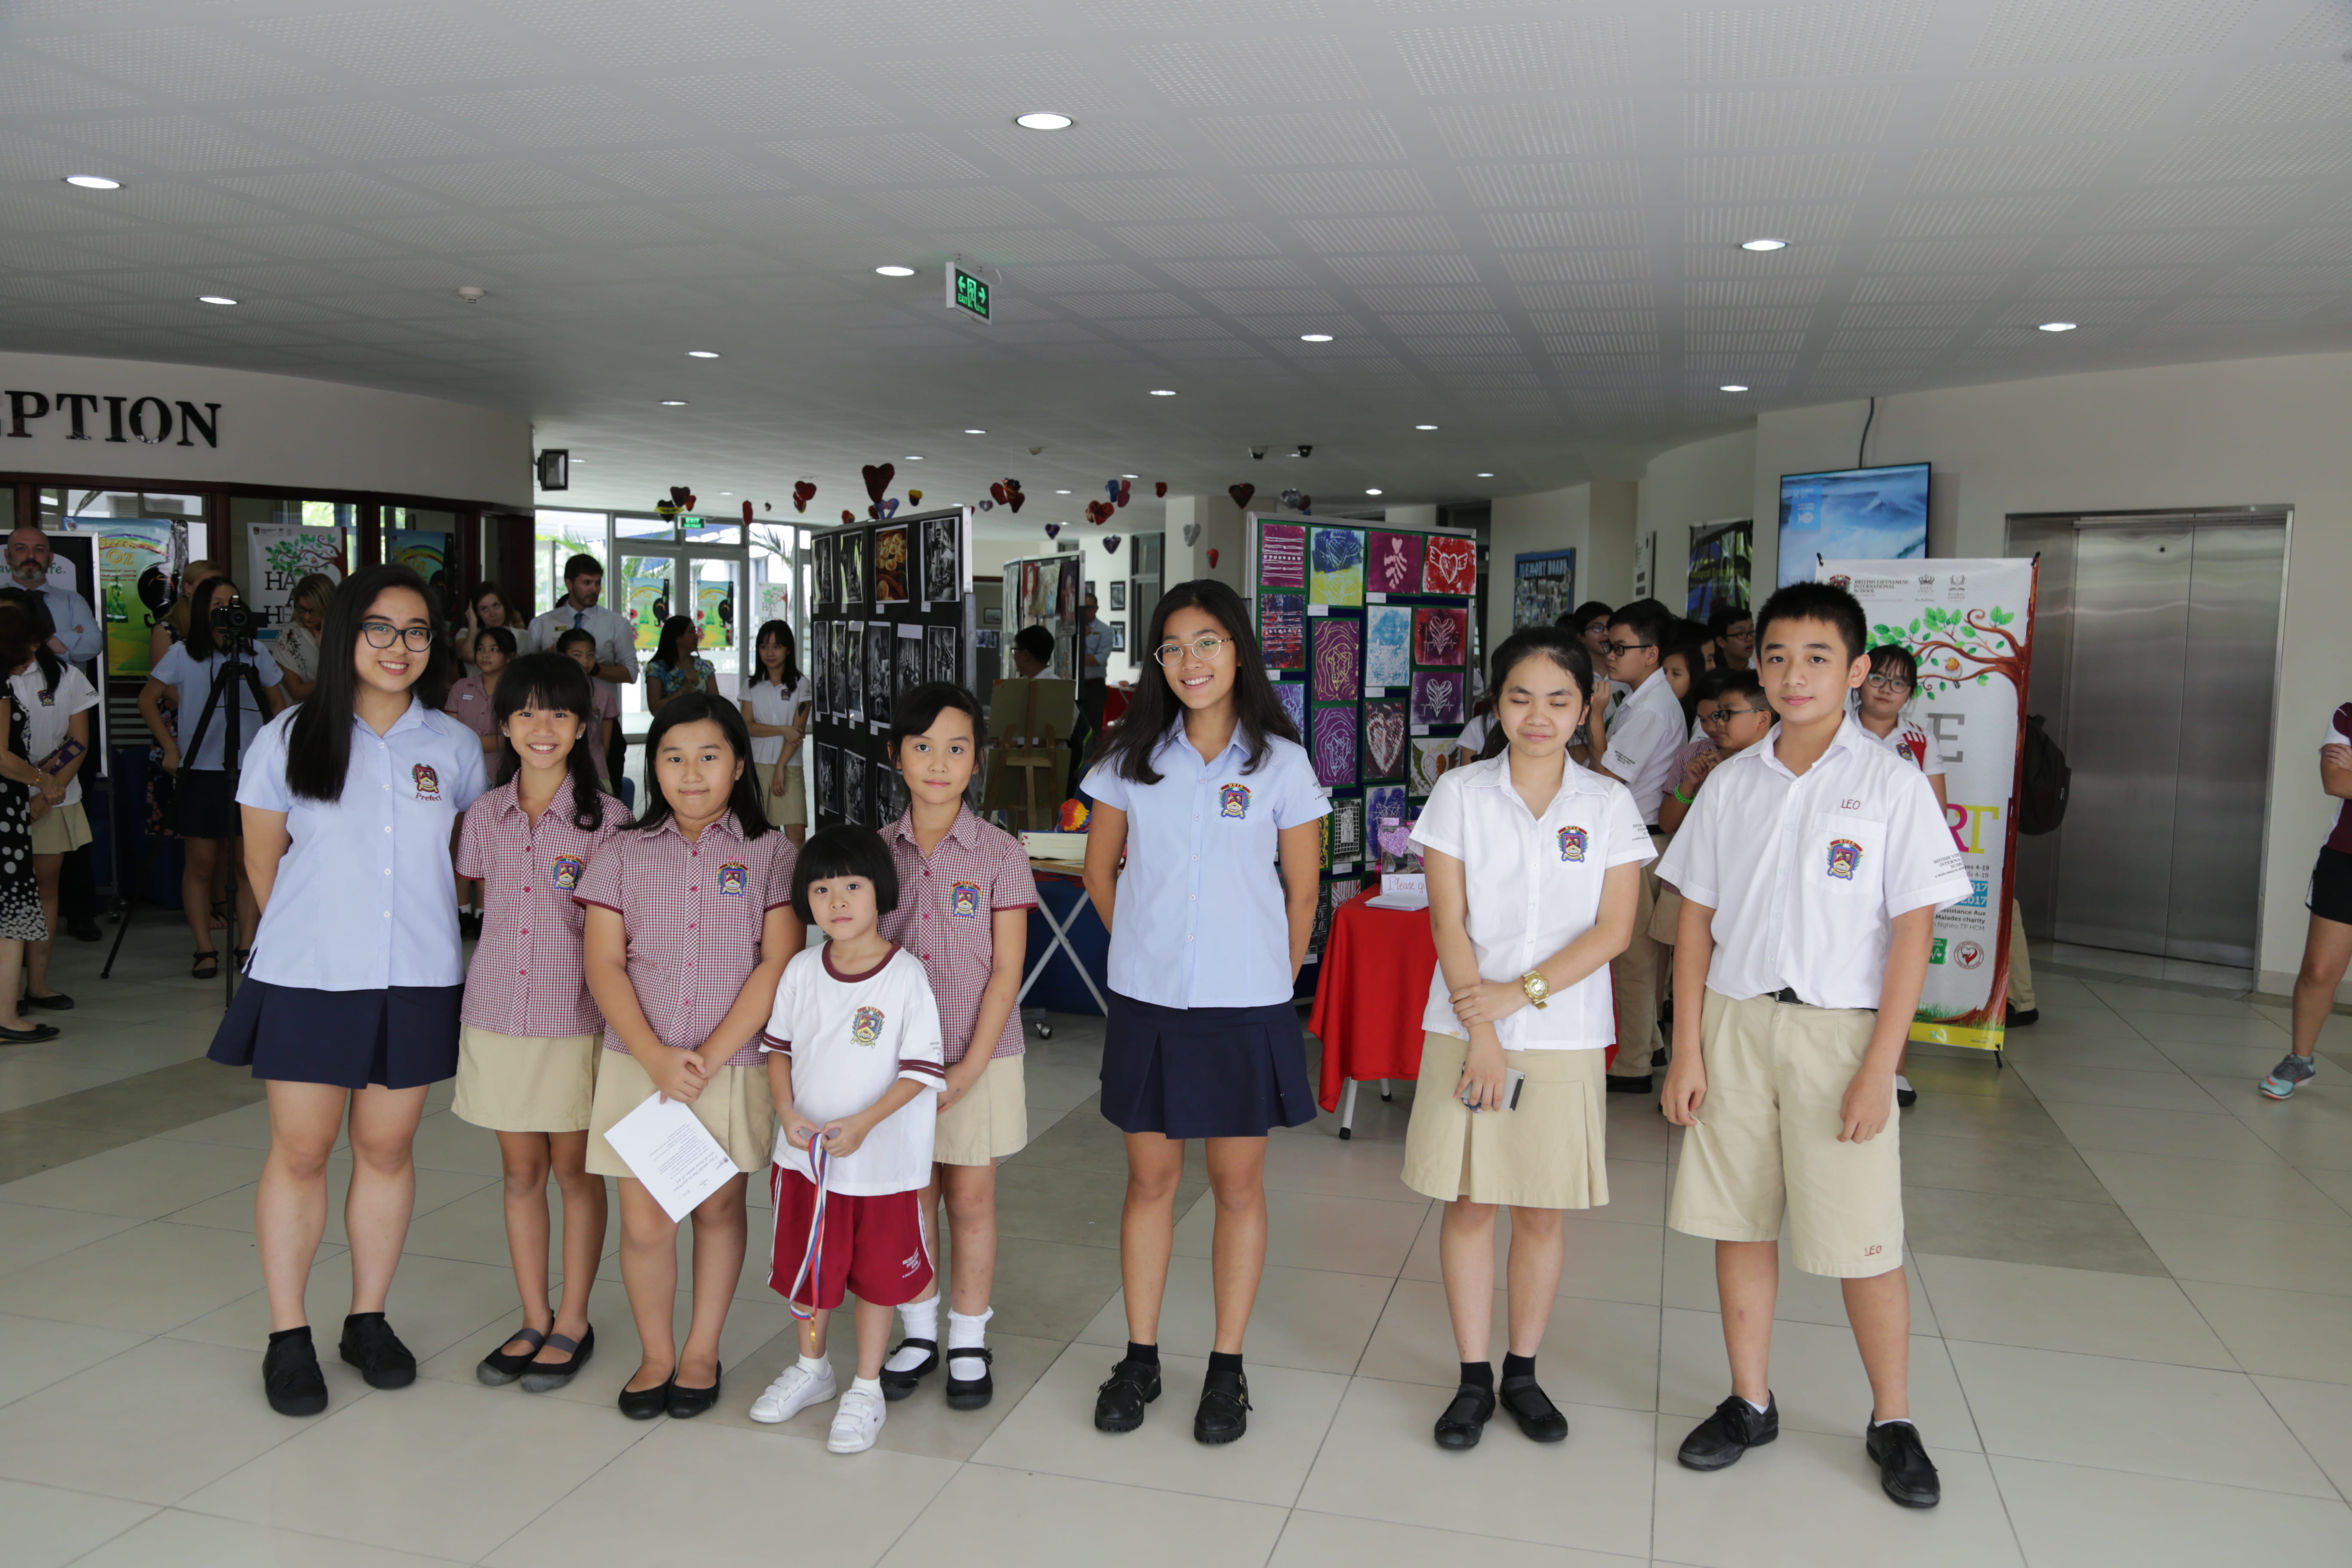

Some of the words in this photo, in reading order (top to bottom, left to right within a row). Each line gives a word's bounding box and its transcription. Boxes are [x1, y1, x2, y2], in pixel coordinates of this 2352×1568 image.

[958, 293, 968, 305] EXIT
[0, 391, 221, 448] PTION
[1519, 560, 1547, 579] MEMORY
[265, 571, 296, 590] HA
[415, 792, 442, 801] Prefect
[1841, 799, 1861, 810] LEO
[1947, 803, 2000, 854] RT
[1387, 876, 1416, 891] Please
[1971, 883, 1988, 892] 017
[1864, 1245, 1882, 1256] LEO
